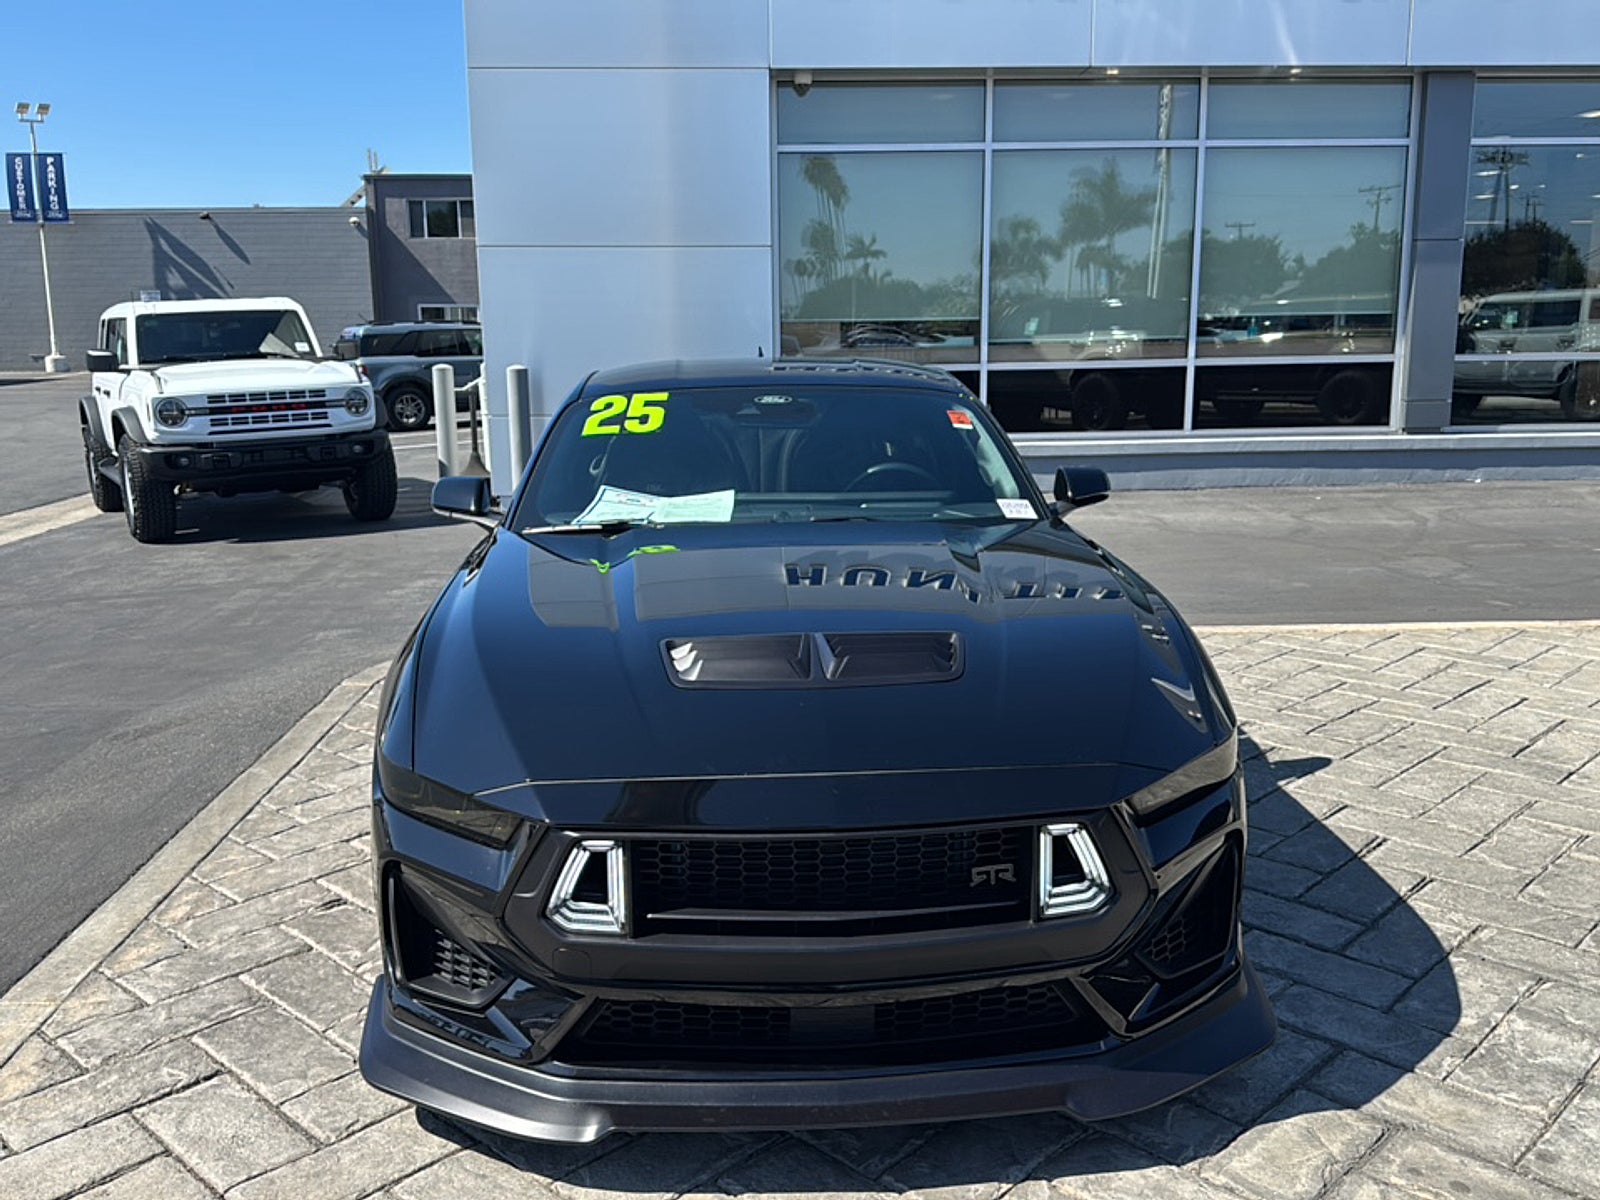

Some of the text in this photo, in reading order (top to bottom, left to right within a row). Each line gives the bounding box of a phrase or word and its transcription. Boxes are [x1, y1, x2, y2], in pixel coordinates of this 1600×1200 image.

[46, 157, 59, 210] PARKING
[581, 391, 670, 437] 25
[969, 863, 1017, 888] RTR
